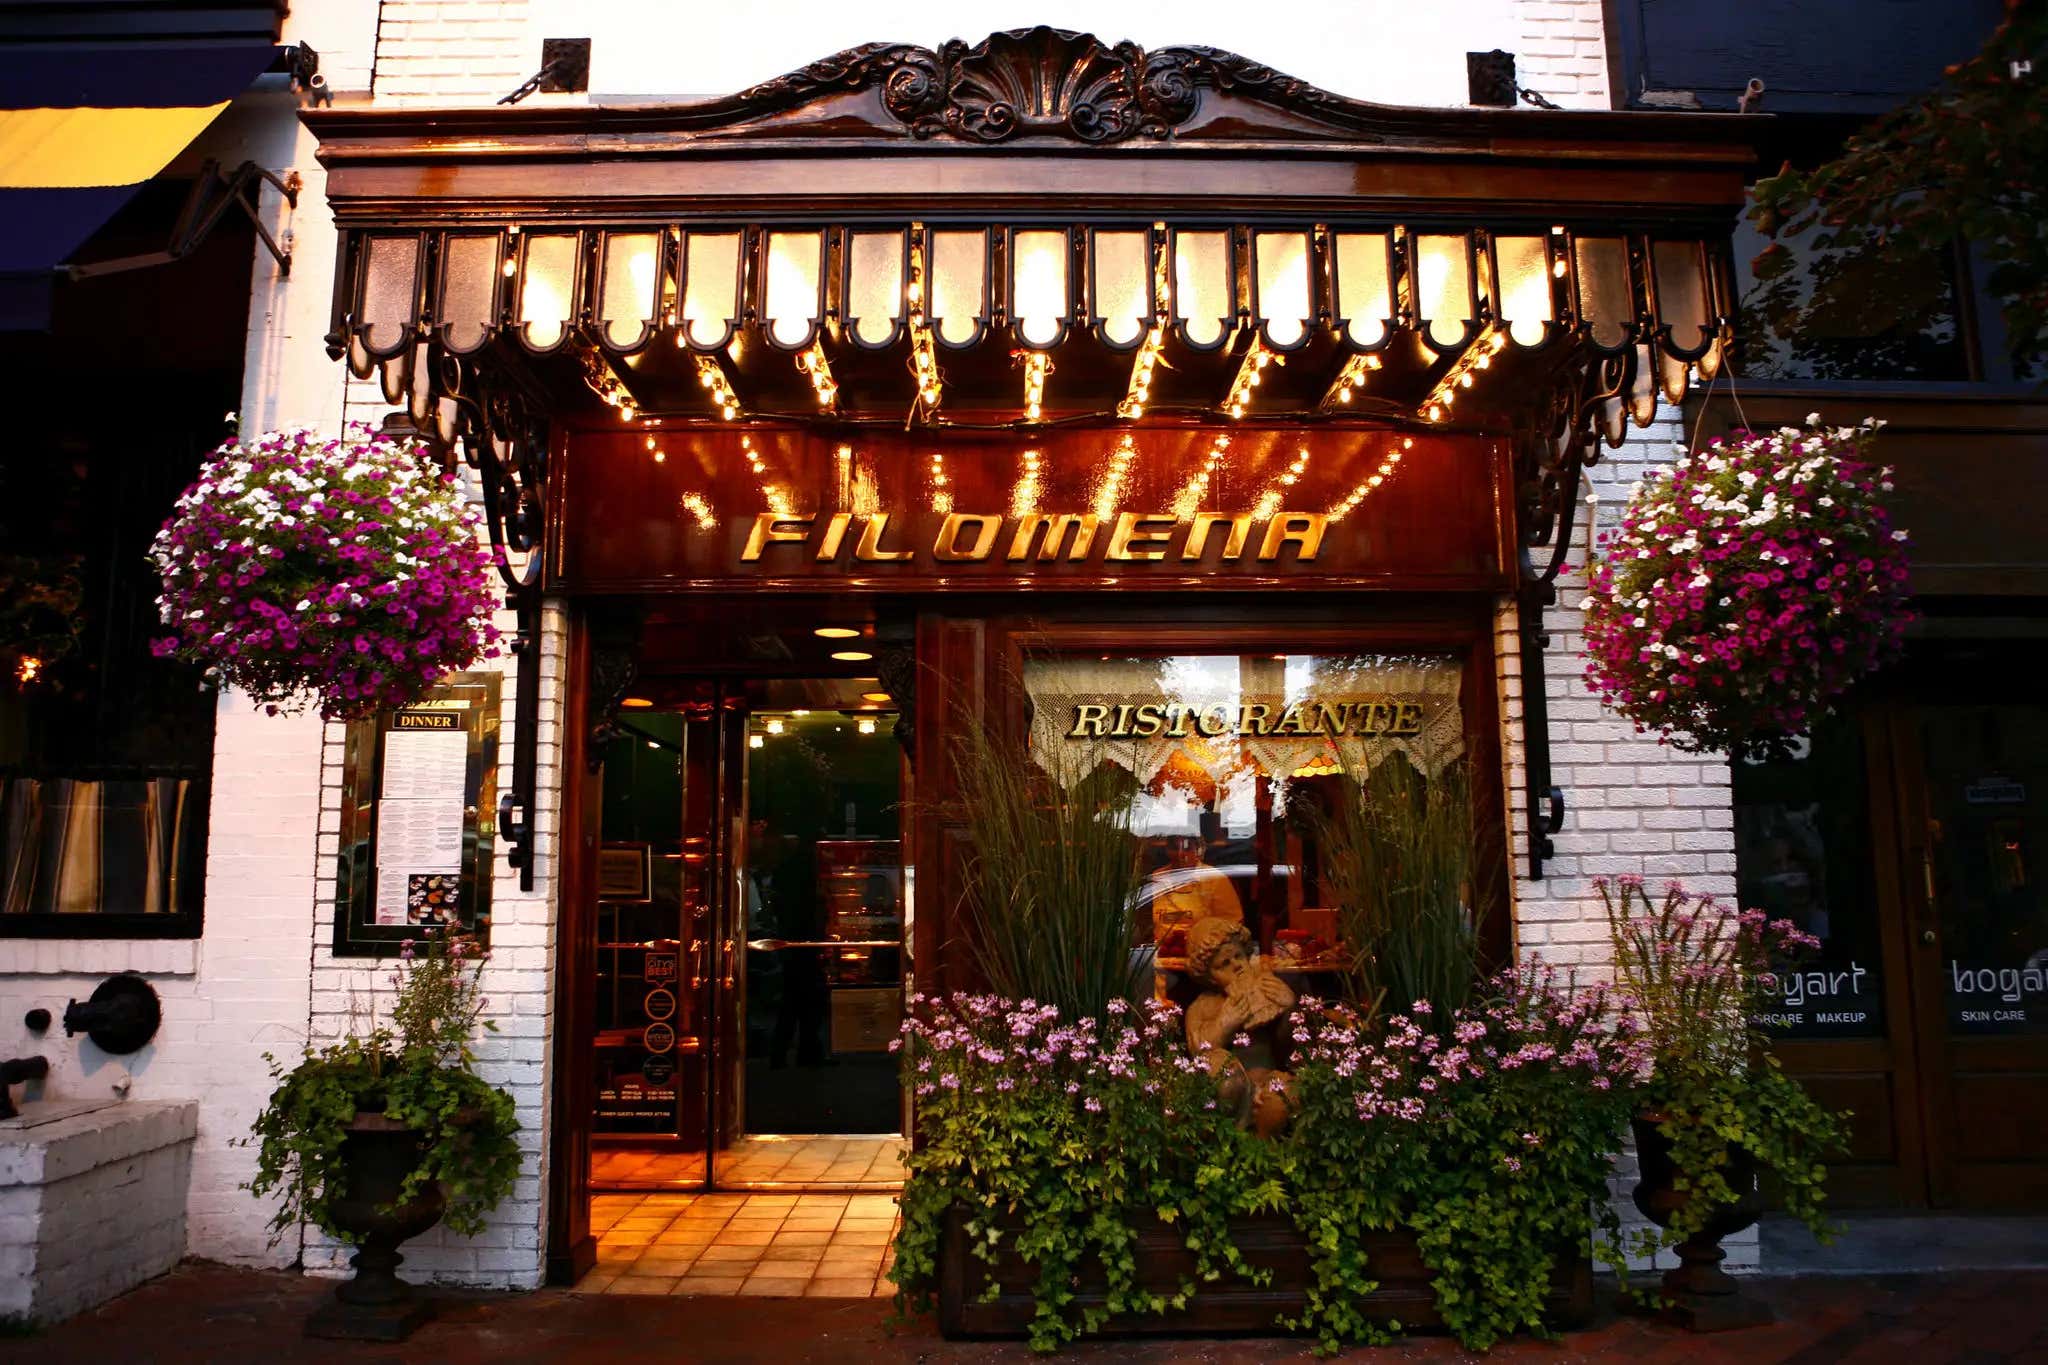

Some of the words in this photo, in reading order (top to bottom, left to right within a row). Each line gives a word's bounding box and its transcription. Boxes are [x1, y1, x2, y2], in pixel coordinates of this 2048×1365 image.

[740, 511, 1330, 563] FILOMENA
[401, 715, 452, 727] DINNER
[1067, 702, 1424, 738] RISTORANTE
[1951, 959, 2048, 1002] boga
[1816, 1012, 1866, 1023] MAKEUP
[1961, 1010, 1991, 1022] SKIN
[1993, 1009, 2025, 1021] CARE
